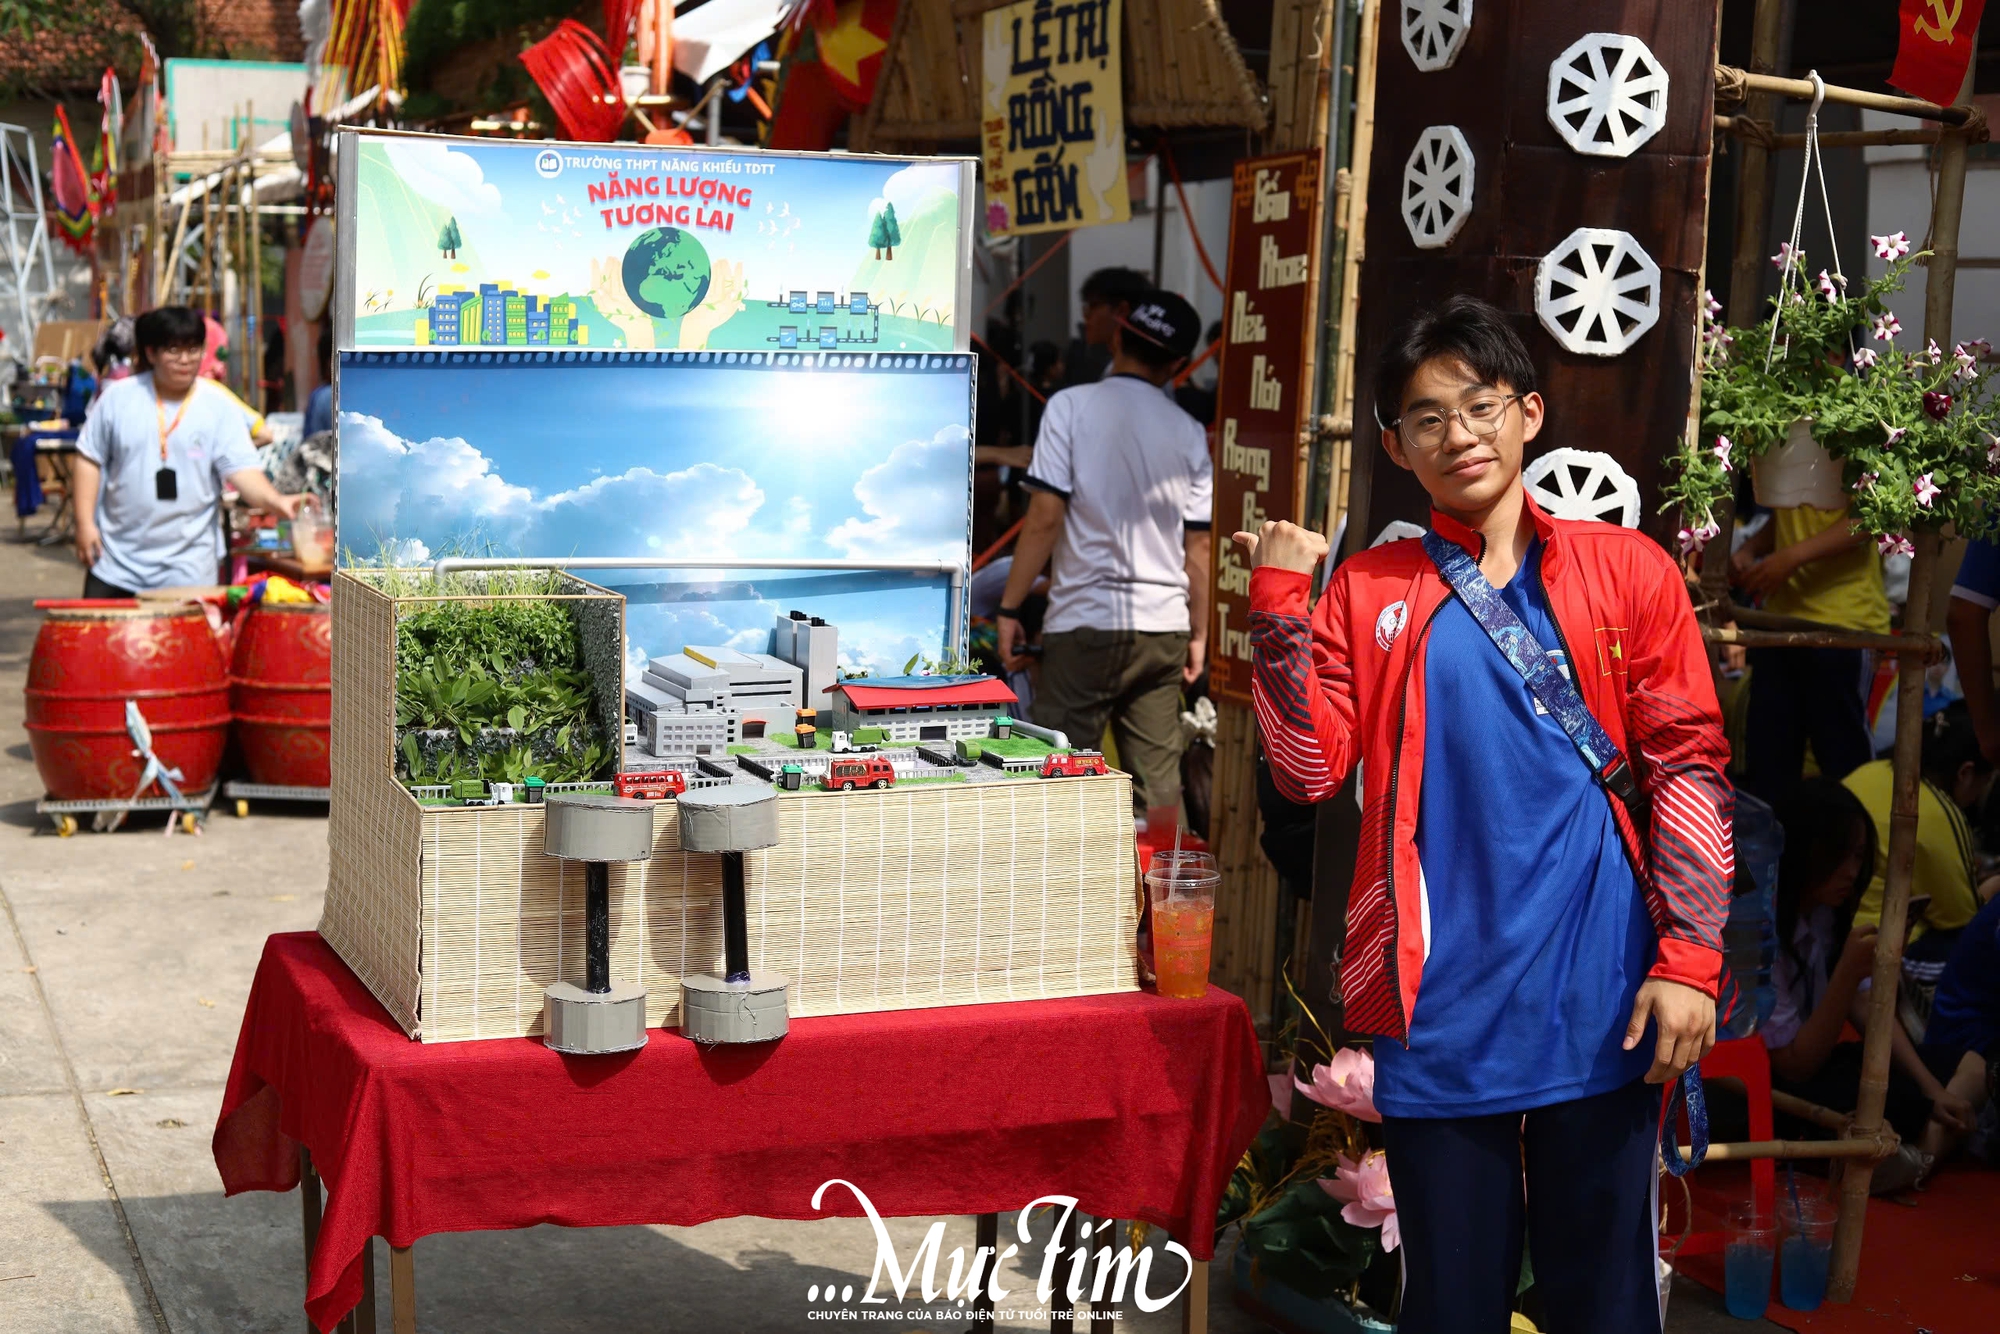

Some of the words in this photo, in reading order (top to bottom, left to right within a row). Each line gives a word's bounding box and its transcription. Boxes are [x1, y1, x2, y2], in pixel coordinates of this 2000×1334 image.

[1008, 69, 1095, 153] RỒNG
[564, 155, 622, 170] TRƯỜNG
[625, 158, 658, 171] THPT
[661, 157, 699, 172] NĂNG
[702, 158, 741, 174] KHIẾU
[745, 163, 775, 175] TDTT
[587, 171, 660, 204] NĂNG
[665, 175, 752, 208] LƯỢNG
[1013, 143, 1083, 226] GẤM
[600, 202, 690, 229] TƯƠNG
[695, 207, 734, 232] LAI
